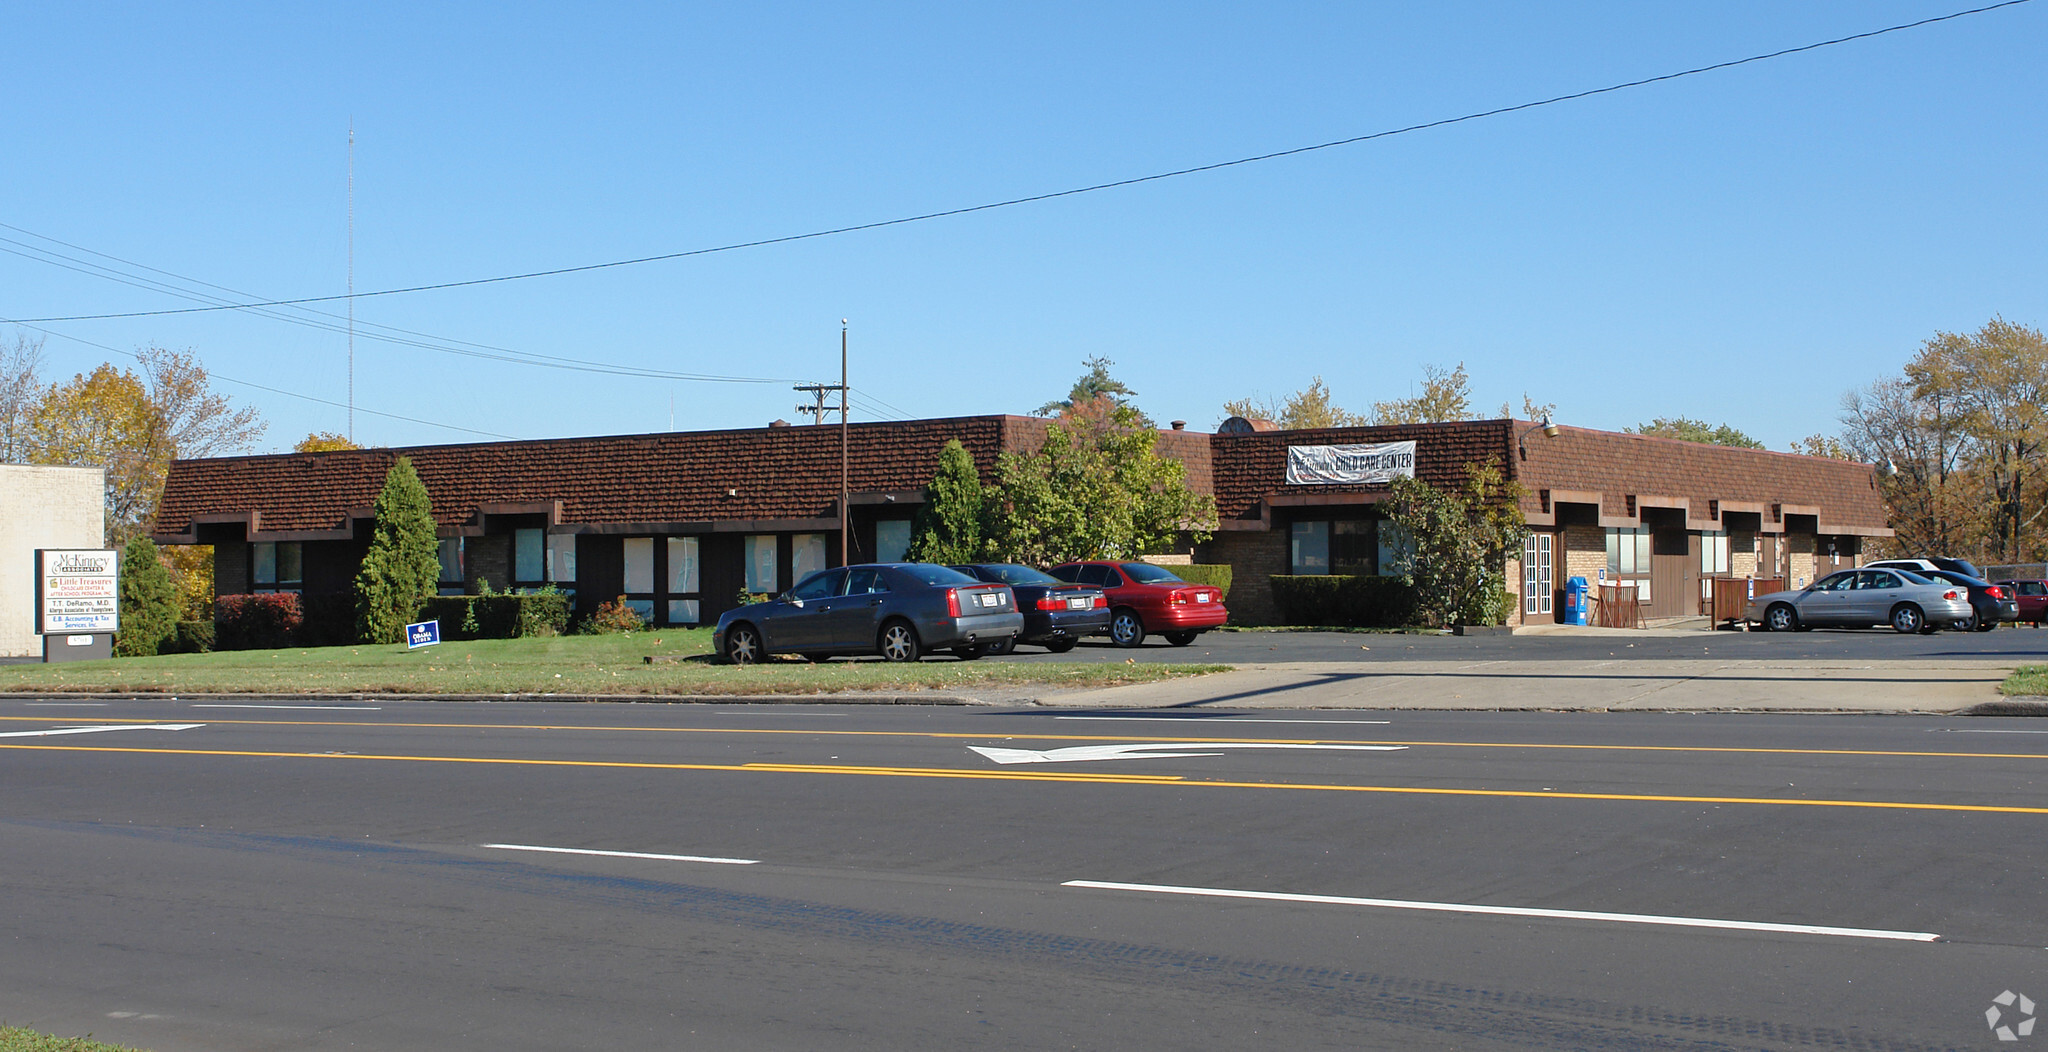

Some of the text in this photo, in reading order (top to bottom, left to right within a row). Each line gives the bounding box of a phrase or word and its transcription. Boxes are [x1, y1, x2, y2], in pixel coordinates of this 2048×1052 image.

[1336, 456, 1358, 471] CHILD
[1359, 455, 1380, 470] CARE
[1381, 453, 1412, 469] CENTER
[60, 554, 110, 570] McKinney
[80, 577, 112, 585] Treasures
[413, 632, 432, 640] OBAMA
